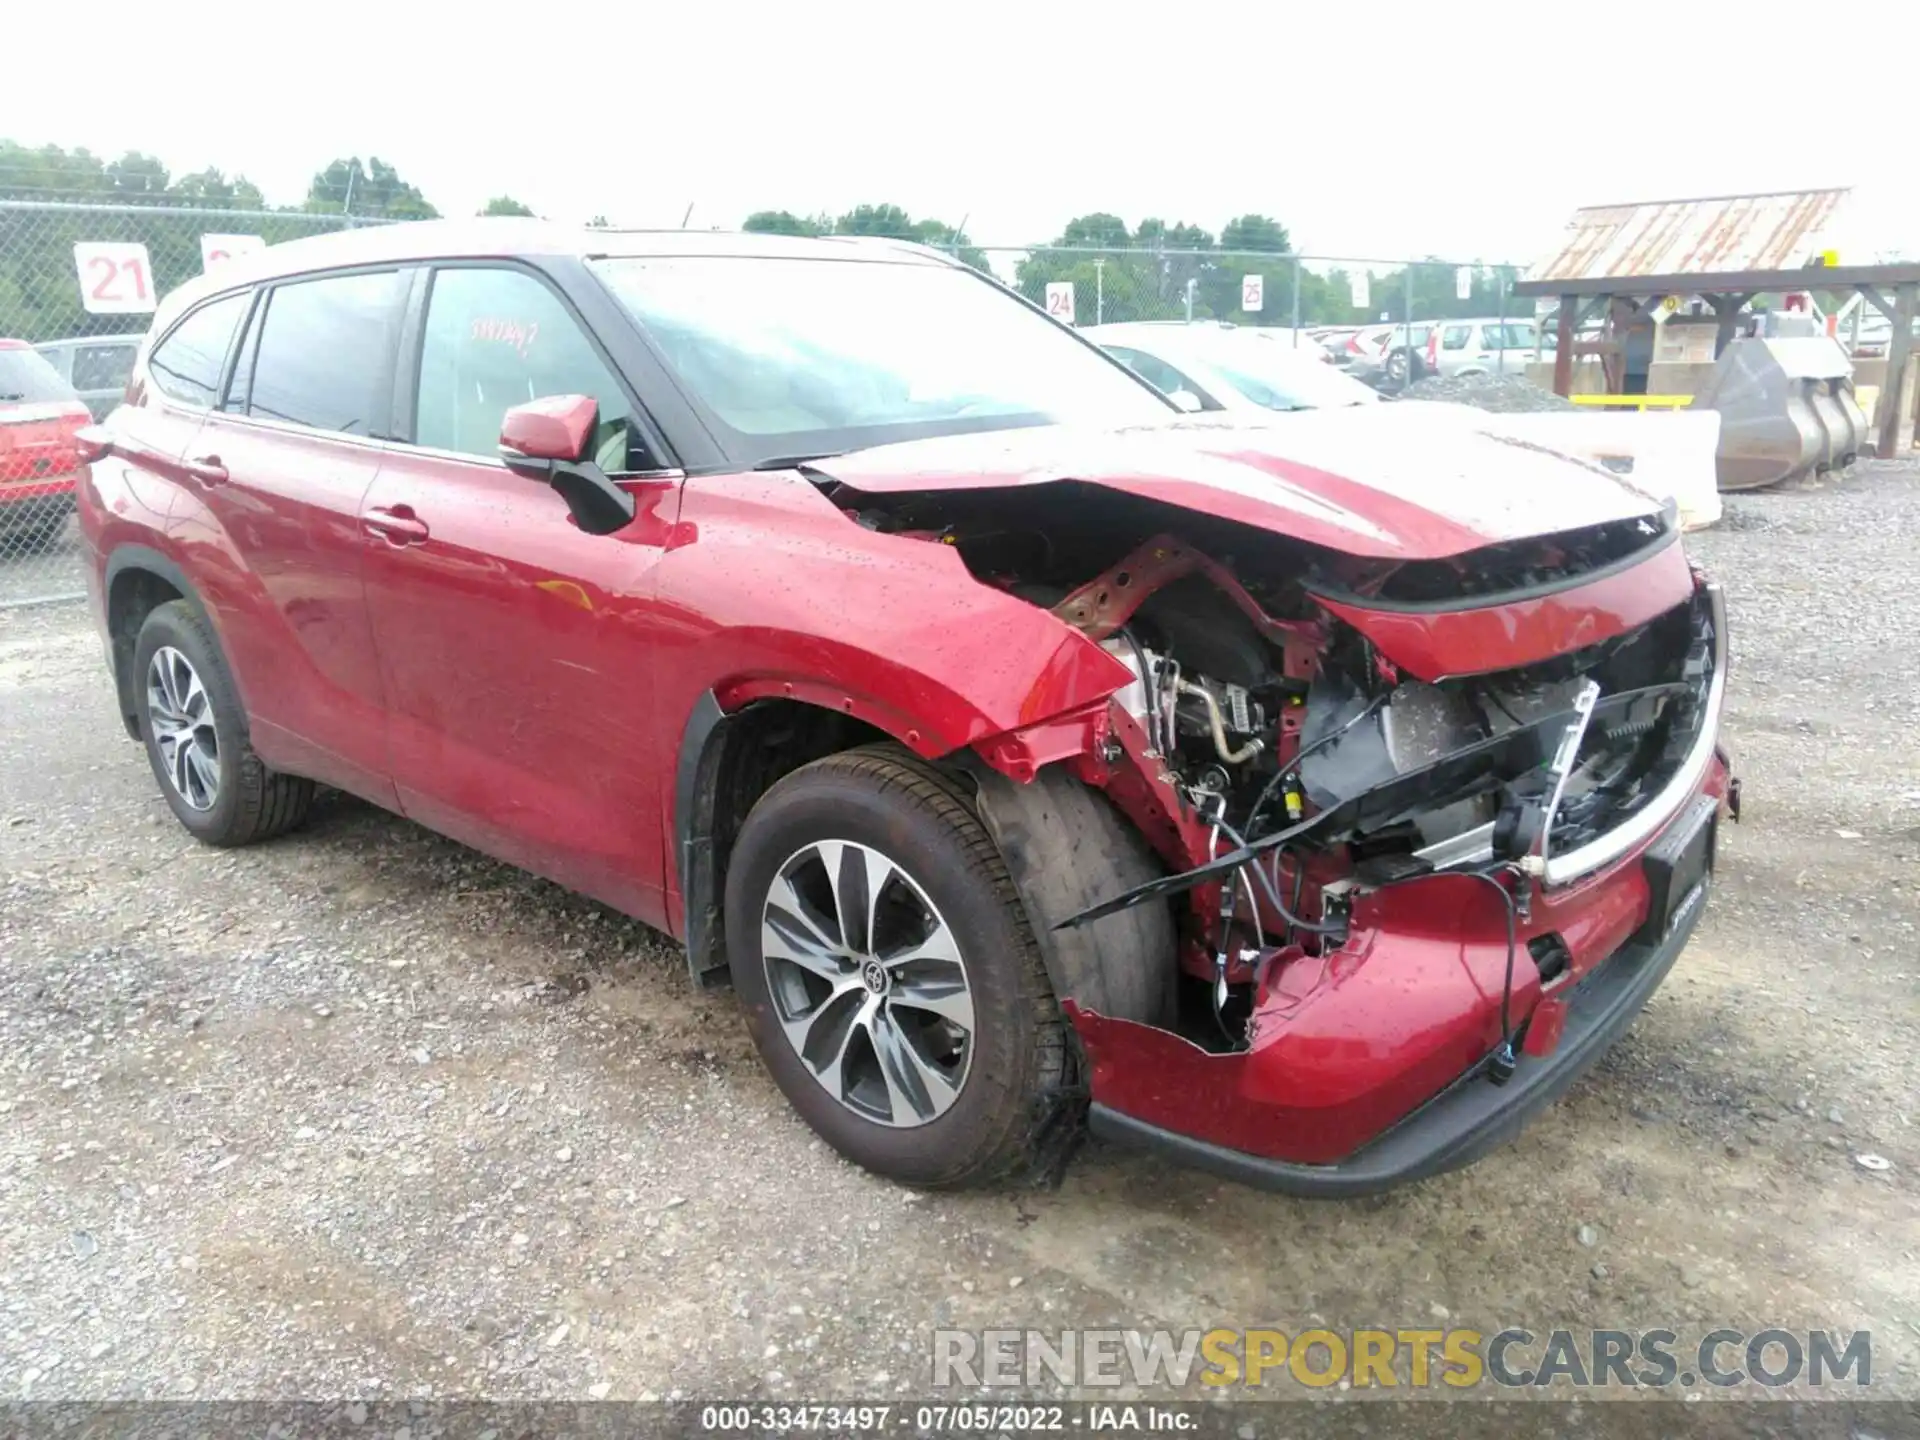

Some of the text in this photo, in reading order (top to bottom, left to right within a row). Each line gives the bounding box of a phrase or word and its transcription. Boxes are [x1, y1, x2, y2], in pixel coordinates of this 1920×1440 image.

[87, 256, 147, 301] 21
[1050, 291, 1071, 315] 24
[1245, 283, 1260, 303] 25
